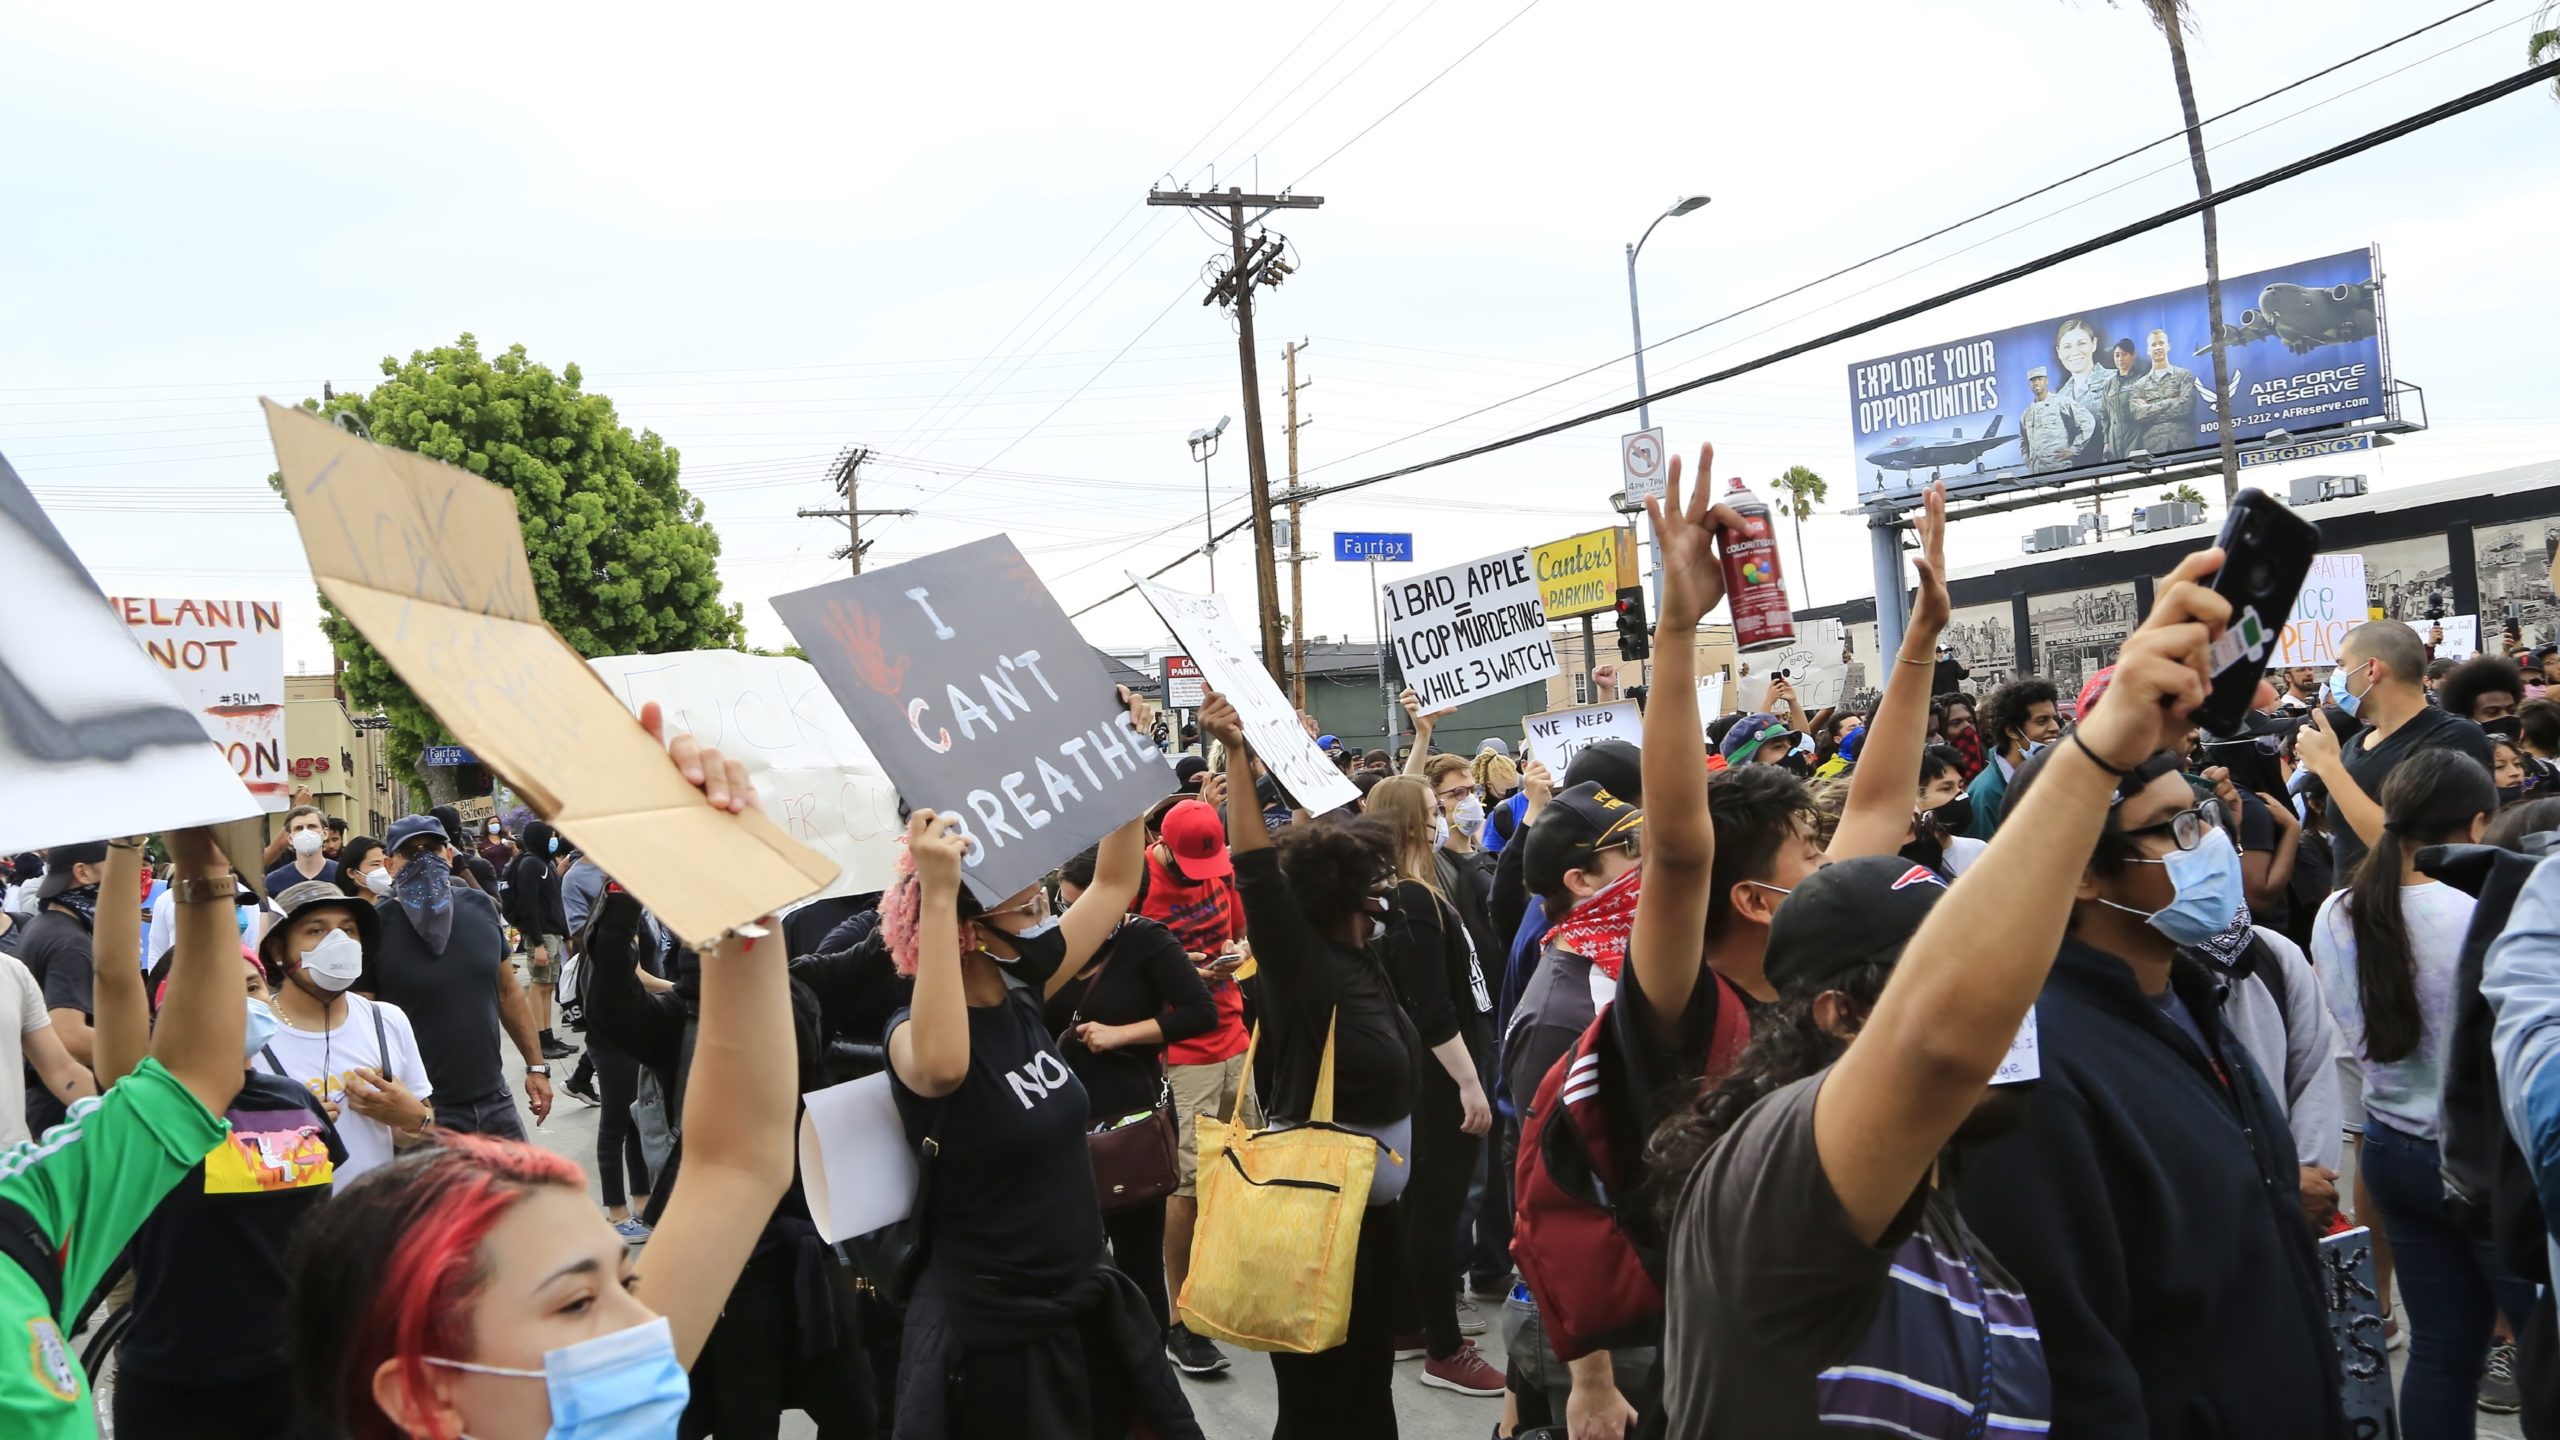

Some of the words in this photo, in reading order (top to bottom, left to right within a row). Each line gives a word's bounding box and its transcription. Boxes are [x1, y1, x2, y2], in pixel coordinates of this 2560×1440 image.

[1856, 353, 1937, 400] EXPLORE
[1942, 339, 1996, 381] YOUR
[2250, 377, 2288, 396] AIR
[2292, 363, 2366, 389] FORCE
[1859, 376, 1999, 434] OPPORTUNITIES
[2256, 377, 2360, 407] RESERVE
[2282, 396, 2369, 420] AFReserve.com
[2243, 437, 2364, 467] REGENCY
[1344, 538, 1404, 555] Fairfax
[1536, 536, 1613, 583] Canter's
[904, 586, 955, 640] I
[1404, 576, 1455, 616] BAD
[1549, 579, 1605, 611] PARKING
[1397, 637, 1414, 670] 1
[1411, 624, 1450, 665] COP
[1452, 600, 1545, 652] MURDERING
[2281, 620, 2364, 664] PEAC
[147, 639, 237, 671] NOT
[1409, 667, 1470, 708] WHILE
[1470, 660, 1490, 690] 3
[1488, 640, 1556, 683] WATCH
[220, 693, 260, 705] #BLM
[907, 649, 1059, 755] CAN'T
[1532, 719, 1562, 739] WE
[1575, 711, 1614, 729] NEED
[430, 748, 461, 758] Fairfax
[938, 710, 1162, 868] BREATHE
